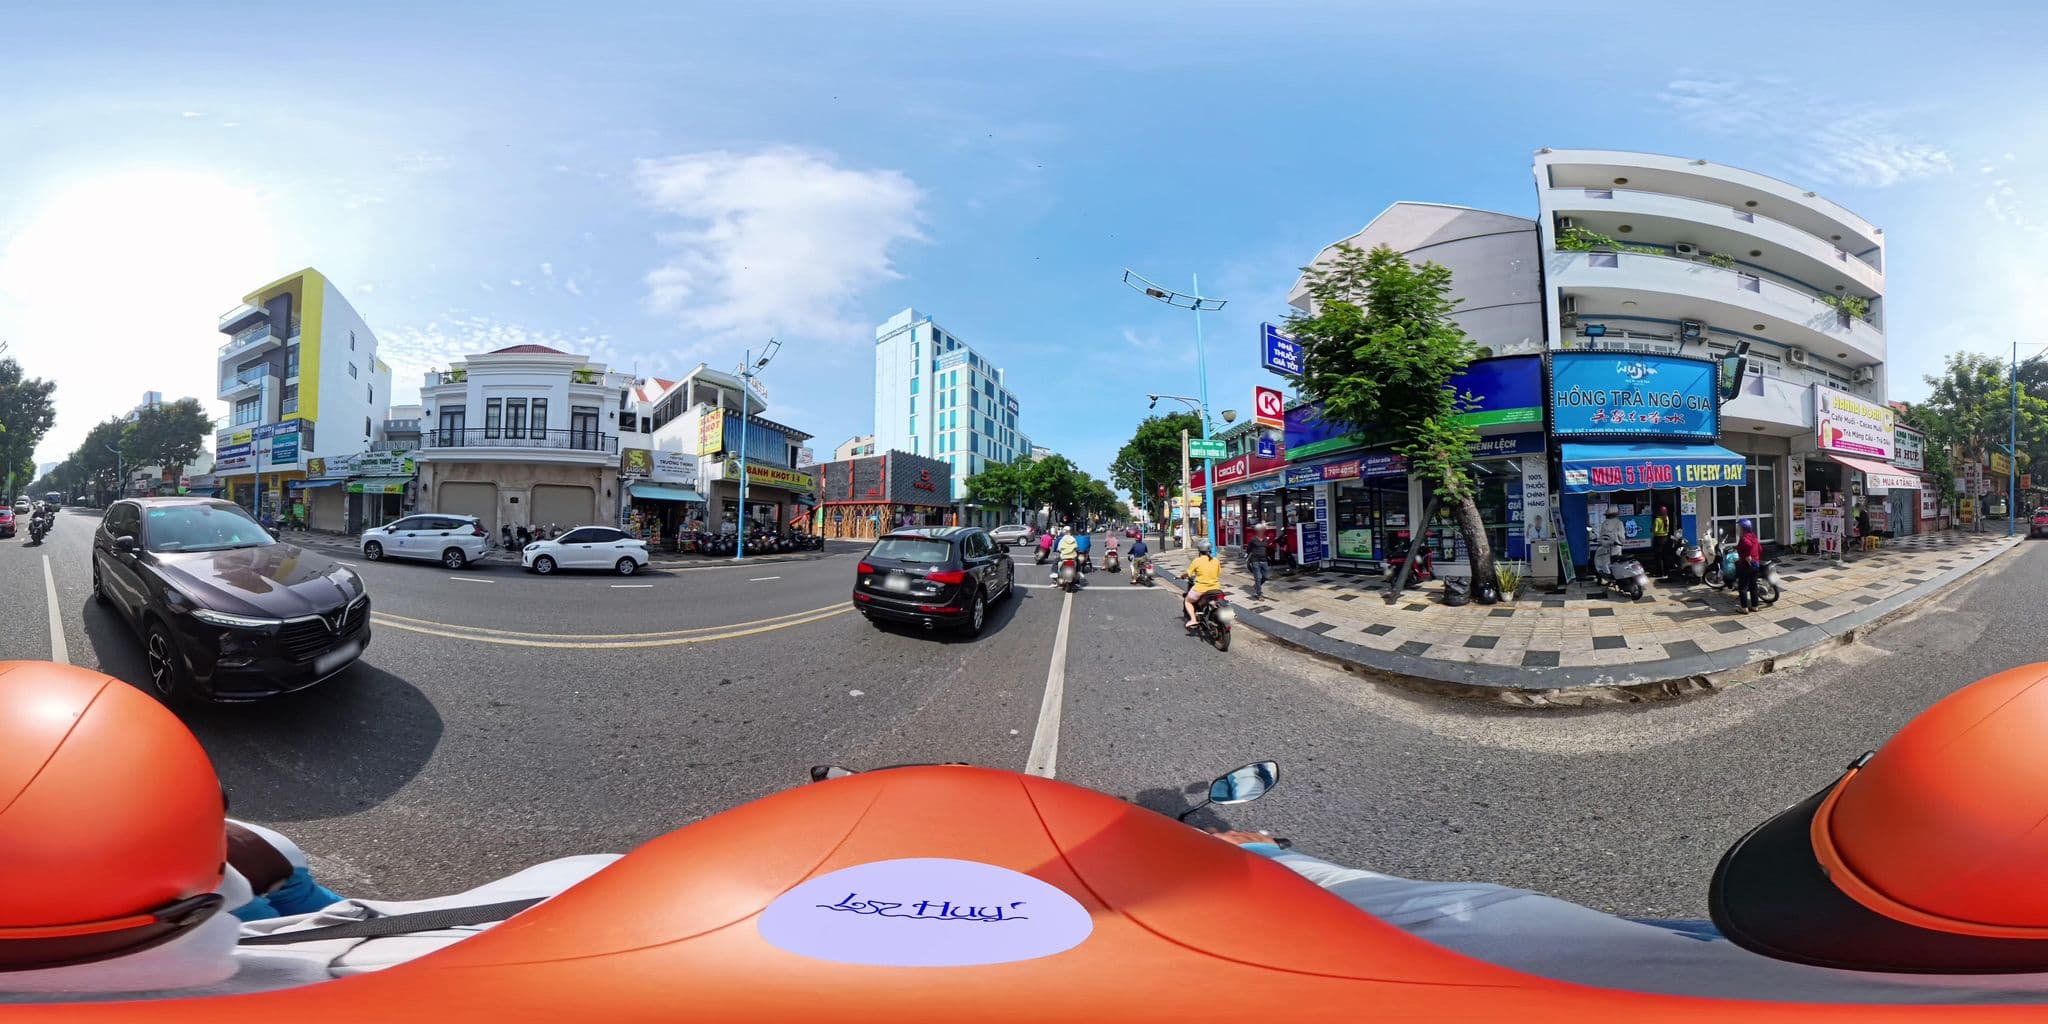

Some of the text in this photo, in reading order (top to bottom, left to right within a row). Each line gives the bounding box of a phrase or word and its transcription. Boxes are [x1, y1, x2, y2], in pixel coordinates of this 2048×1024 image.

[1263, 394, 1279, 415] K
[1557, 385, 1712, 412] HỒNG TRÀ NGÔ GIA
[1525, 481, 1546, 489] THUỐC
[1591, 466, 1623, 486] MUA
[1625, 467, 1635, 484] 5
[1638, 461, 1673, 488] TẶNG
[1675, 465, 1682, 482] 1
[1686, 464, 1721, 482] EVERY
[1723, 464, 1743, 481] DAY
